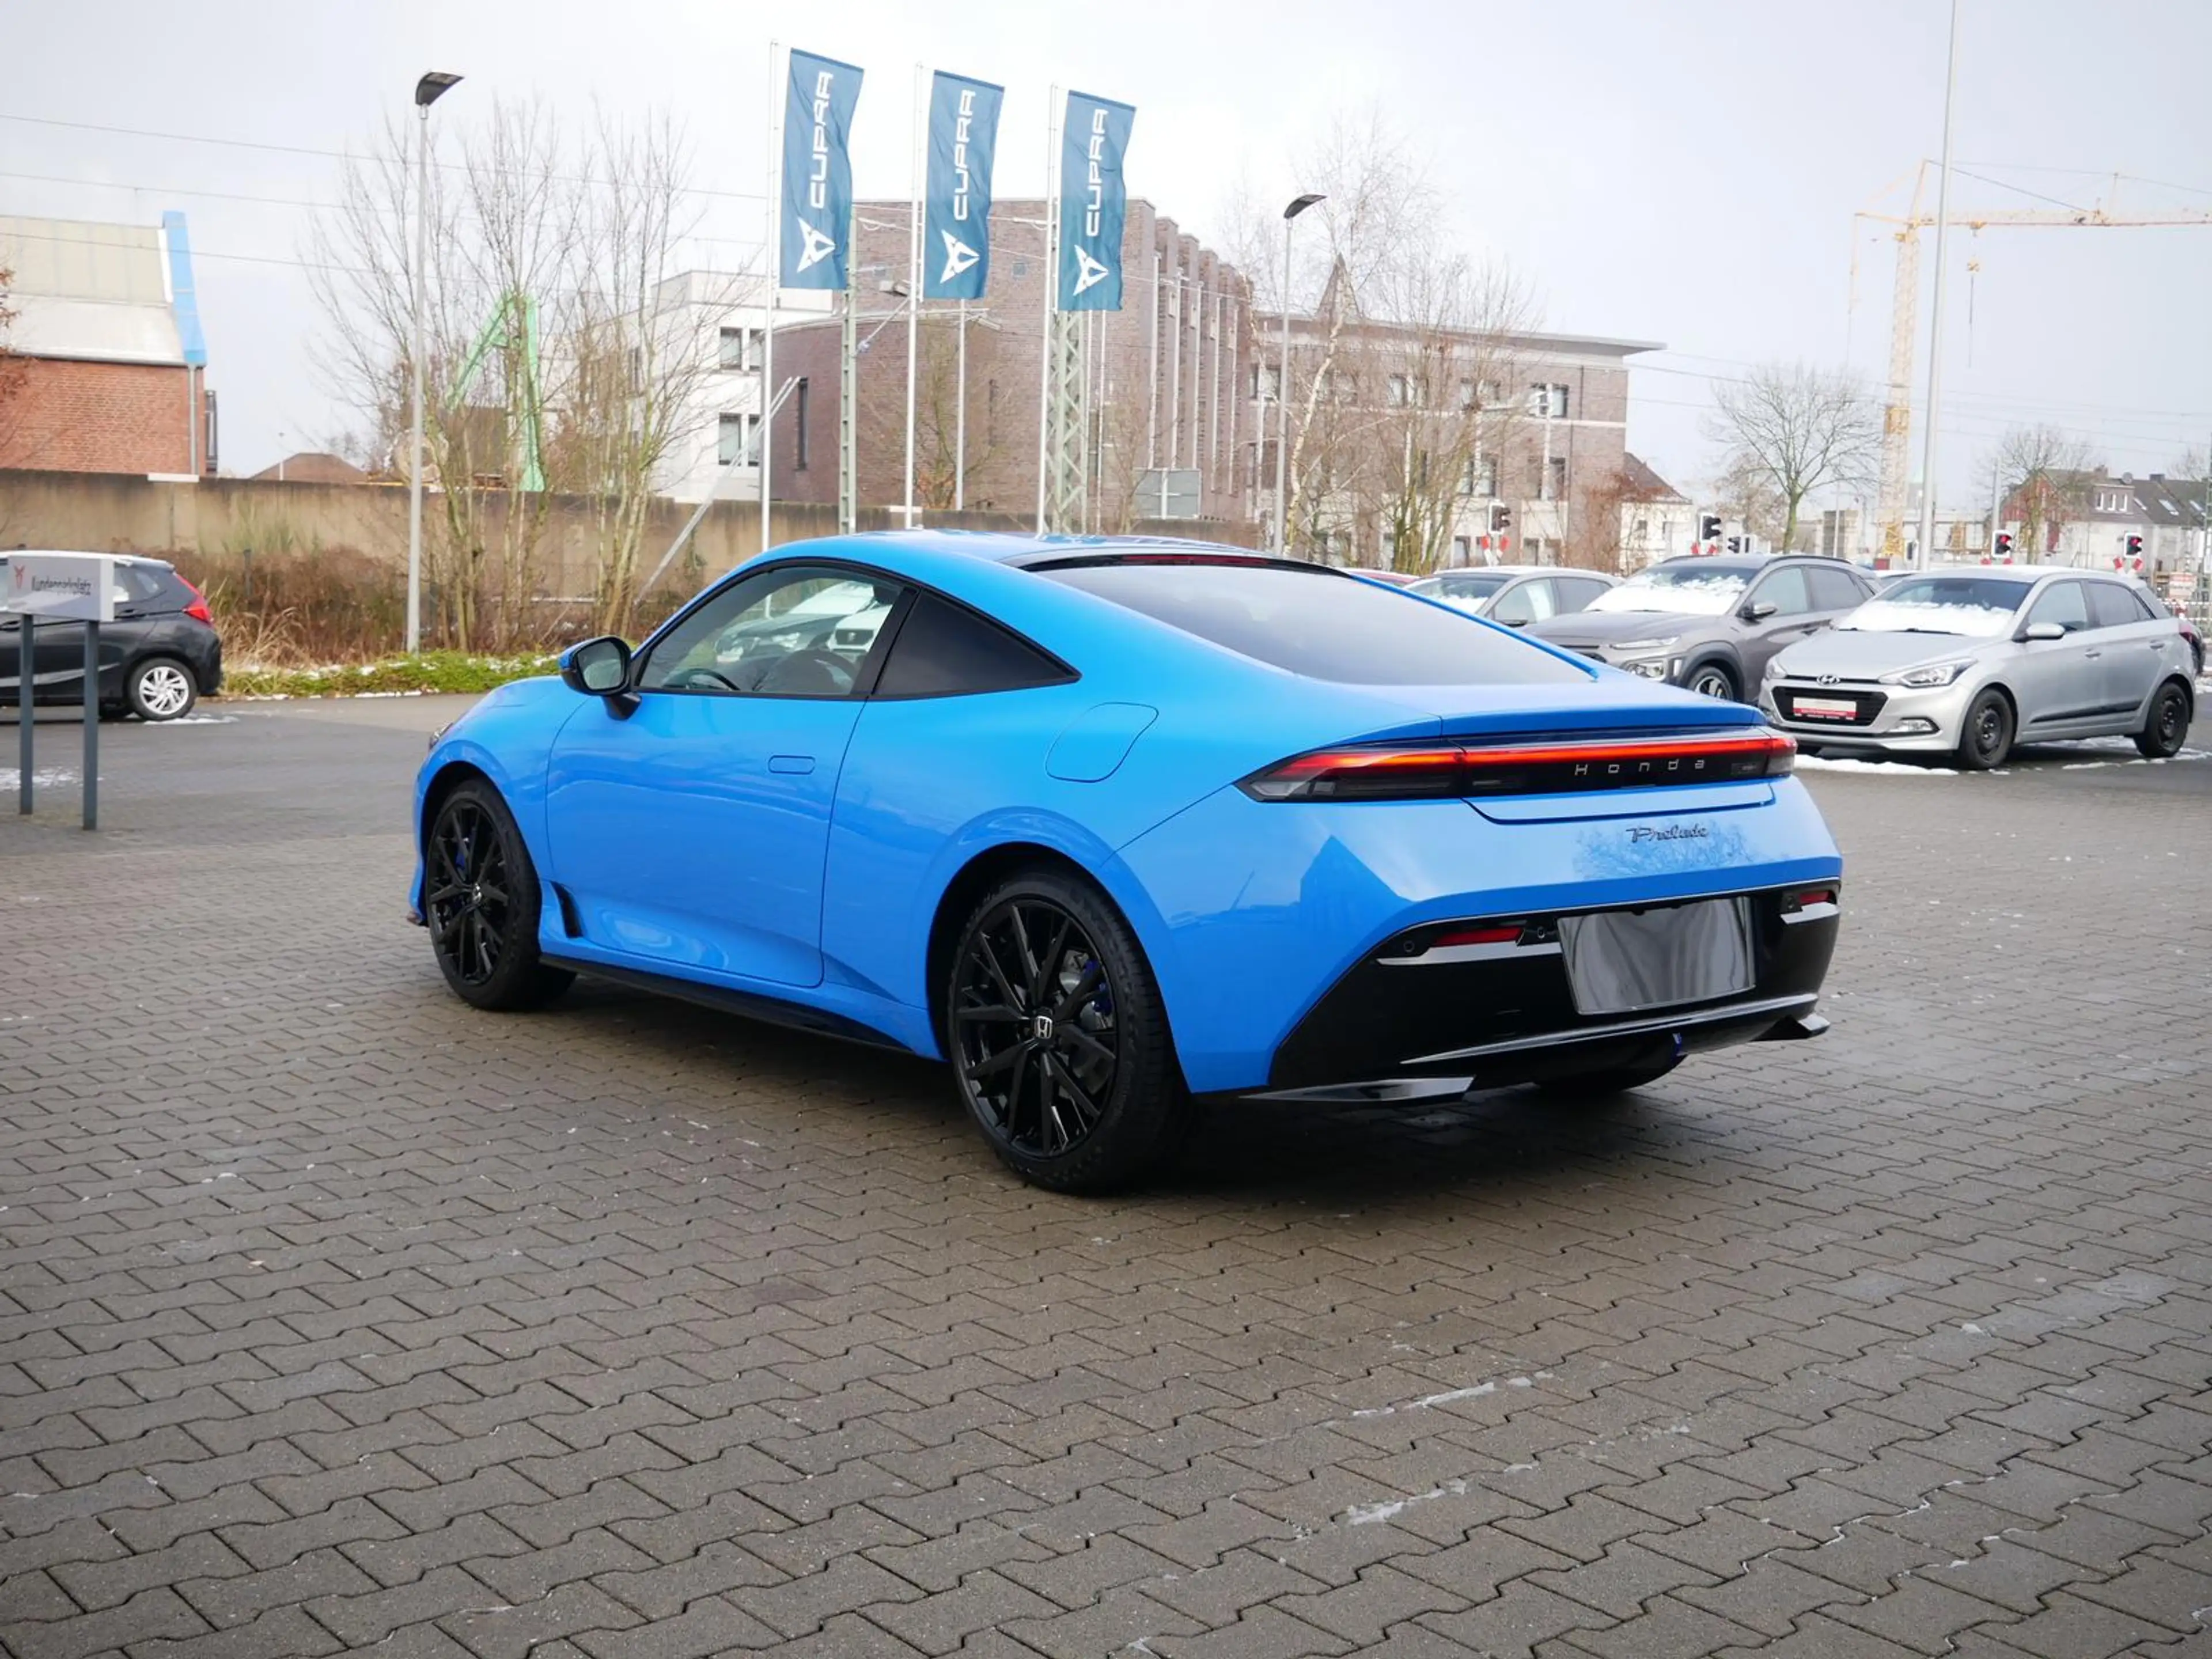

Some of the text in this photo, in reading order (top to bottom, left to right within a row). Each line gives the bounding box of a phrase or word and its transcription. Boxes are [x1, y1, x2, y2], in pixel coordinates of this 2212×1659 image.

[809, 70, 834, 210] CUPRA
[953, 89, 976, 221] CUPRA
[1085, 108, 1109, 237] CUPRA
[1574, 759, 1705, 775] Honda
[1626, 824, 1707, 843] Prelude
